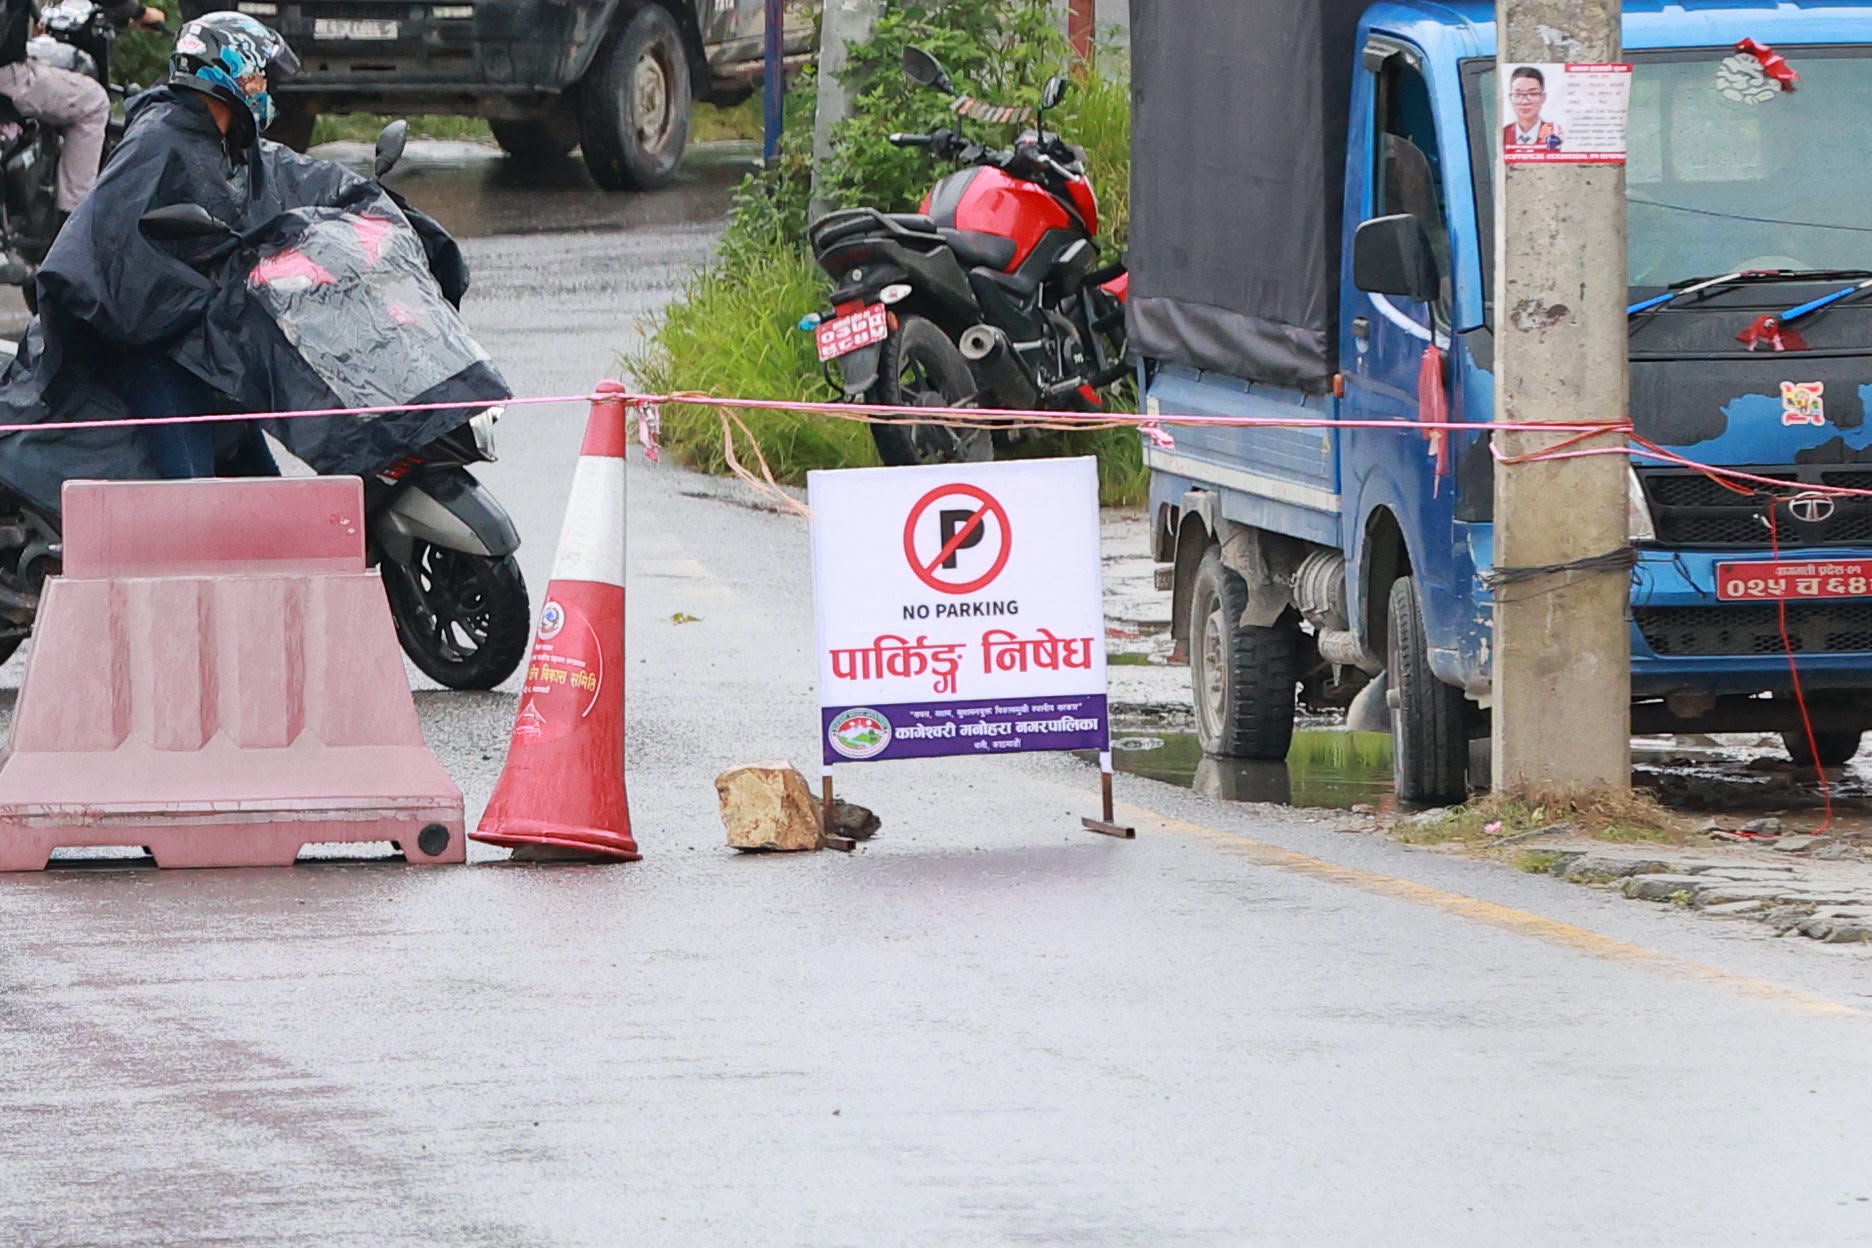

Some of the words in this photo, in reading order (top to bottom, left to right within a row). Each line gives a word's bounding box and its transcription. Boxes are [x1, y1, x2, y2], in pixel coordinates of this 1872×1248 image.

[1727, 578, 1787, 597] ०२५
[1796, 578, 1822, 595] च
[1826, 577, 1872, 594] ६४
[903, 605, 929, 620] NO
[935, 600, 1019, 619] PARKING
[829, 634, 967, 694] पार्किङ्ग
[981, 628, 1095, 674] निषेध
[541, 663, 567, 684] विकास
[570, 669, 596, 692] समिति
[895, 723, 956, 740] कागेश्वरी
[960, 721, 1012, 737] मनोहरा
[1016, 715, 1099, 735] नगरपालिका
